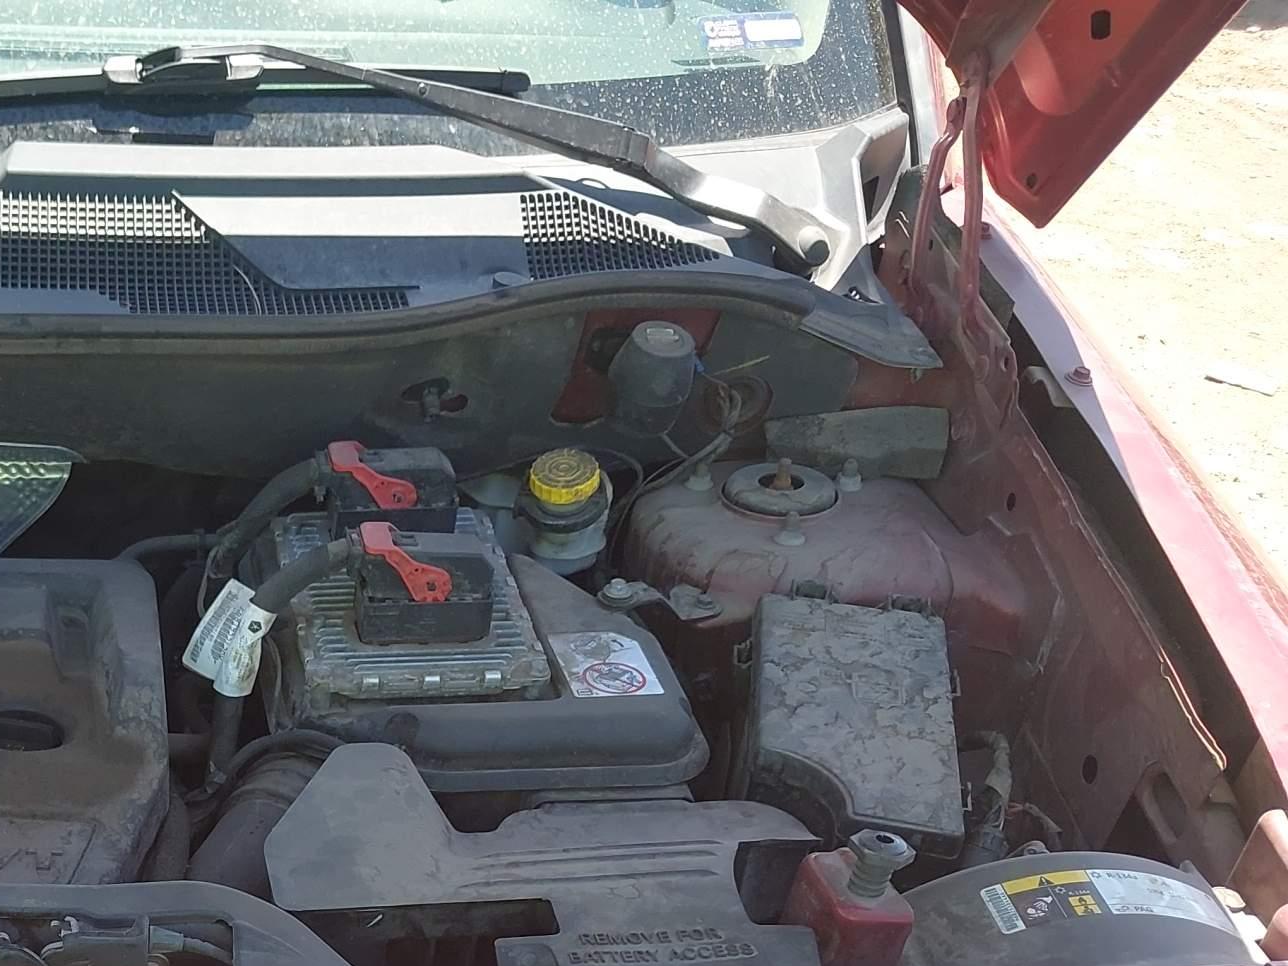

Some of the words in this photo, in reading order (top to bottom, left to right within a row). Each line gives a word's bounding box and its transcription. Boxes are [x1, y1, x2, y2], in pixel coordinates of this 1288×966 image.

[578, 930, 672, 946] REMOVE
[676, 927, 722, 943] FOR
[568, 950, 659, 965] BATTERY
[669, 943, 756, 961] ACCESS
